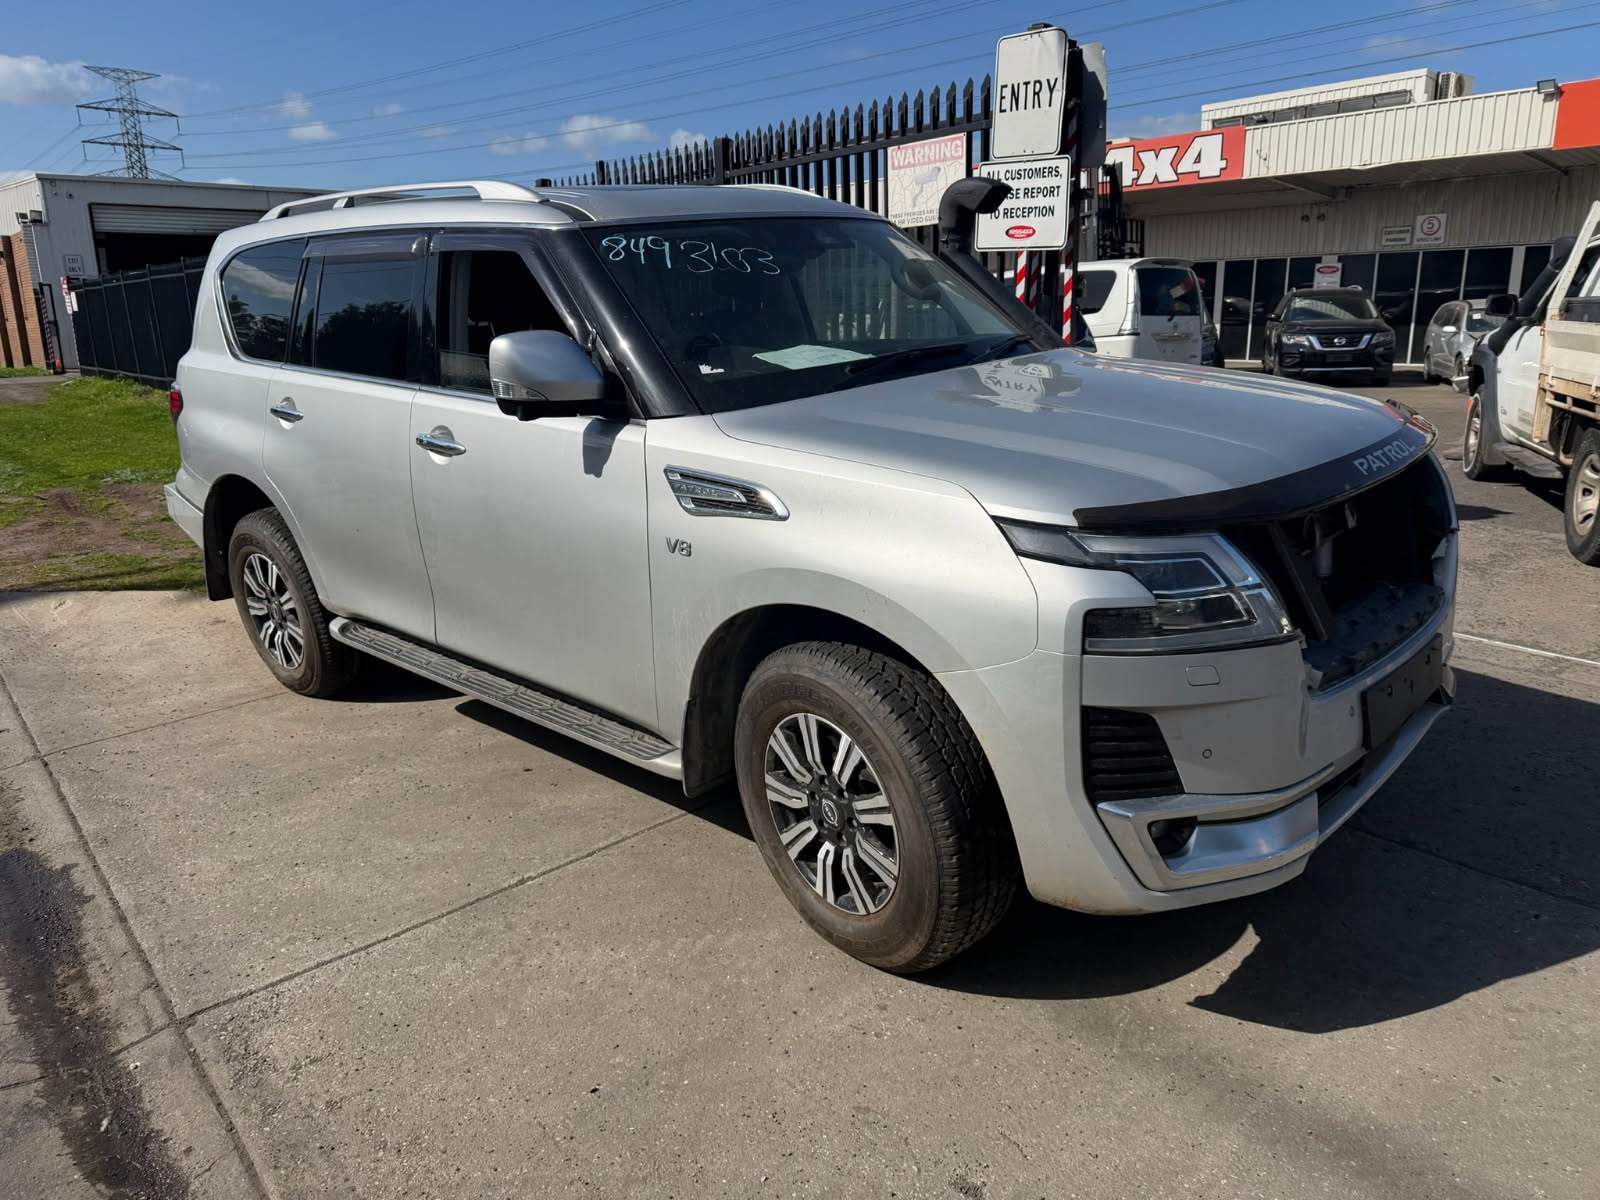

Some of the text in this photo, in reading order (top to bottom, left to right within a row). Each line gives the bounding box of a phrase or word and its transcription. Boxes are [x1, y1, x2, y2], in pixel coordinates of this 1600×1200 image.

[999, 77, 1058, 113] ENTRY
[892, 139, 962, 167] WARNING
[1104, 133, 1228, 187] 4x4
[1004, 165, 1063, 181] CUSTOMERS,
[1023, 185, 1061, 199] REPORT
[906, 216, 924, 224] VIDEO
[1003, 205, 1055, 219] RECEPTION
[1426, 219, 1435, 230] 5
[602, 236, 671, 269] 849
[1352, 439, 1417, 475] PATROL
[666, 536, 692, 557] V8
